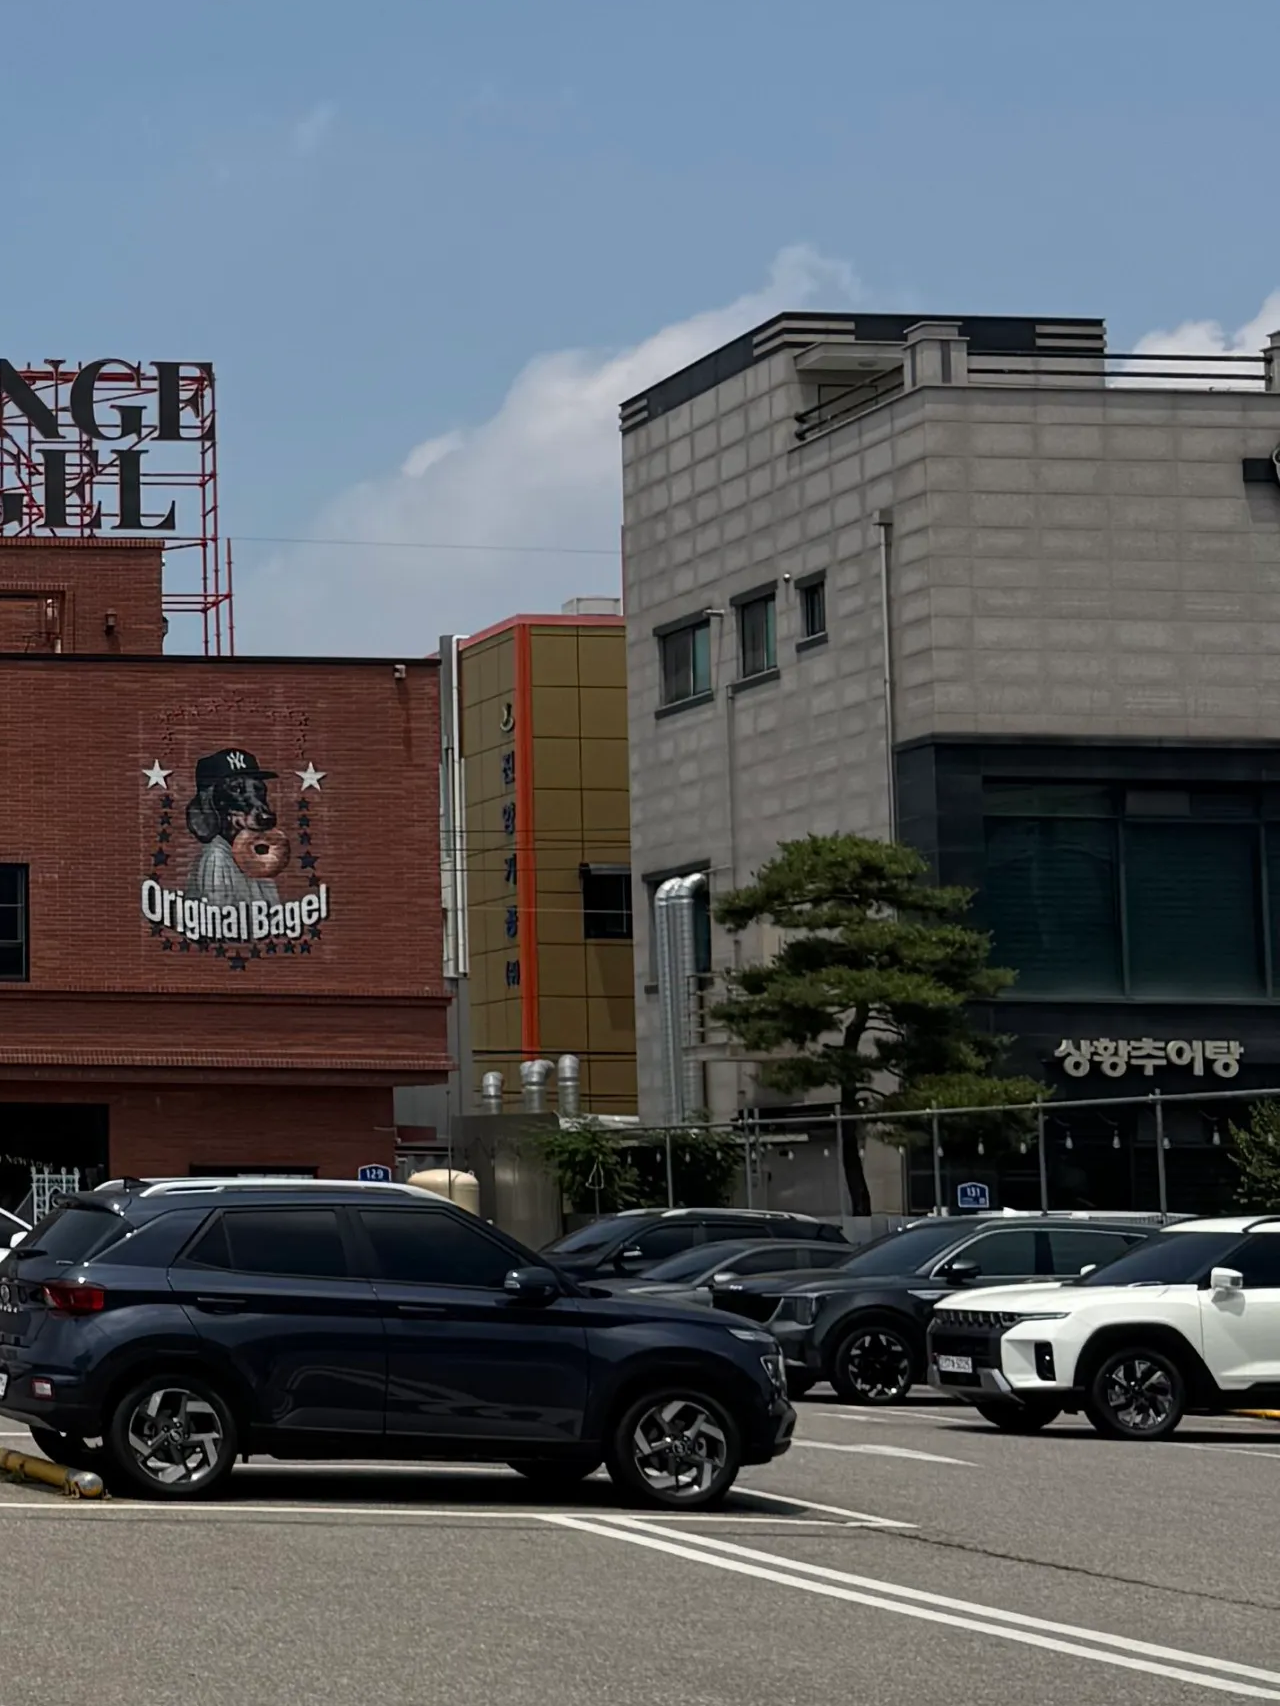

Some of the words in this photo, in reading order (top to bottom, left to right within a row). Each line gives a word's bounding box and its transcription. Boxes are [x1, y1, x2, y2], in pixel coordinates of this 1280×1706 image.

[141, 879, 248, 941] Original
[251, 883, 328, 940] Bagel
[1054, 1037, 1245, 1078] 상황추어탕
